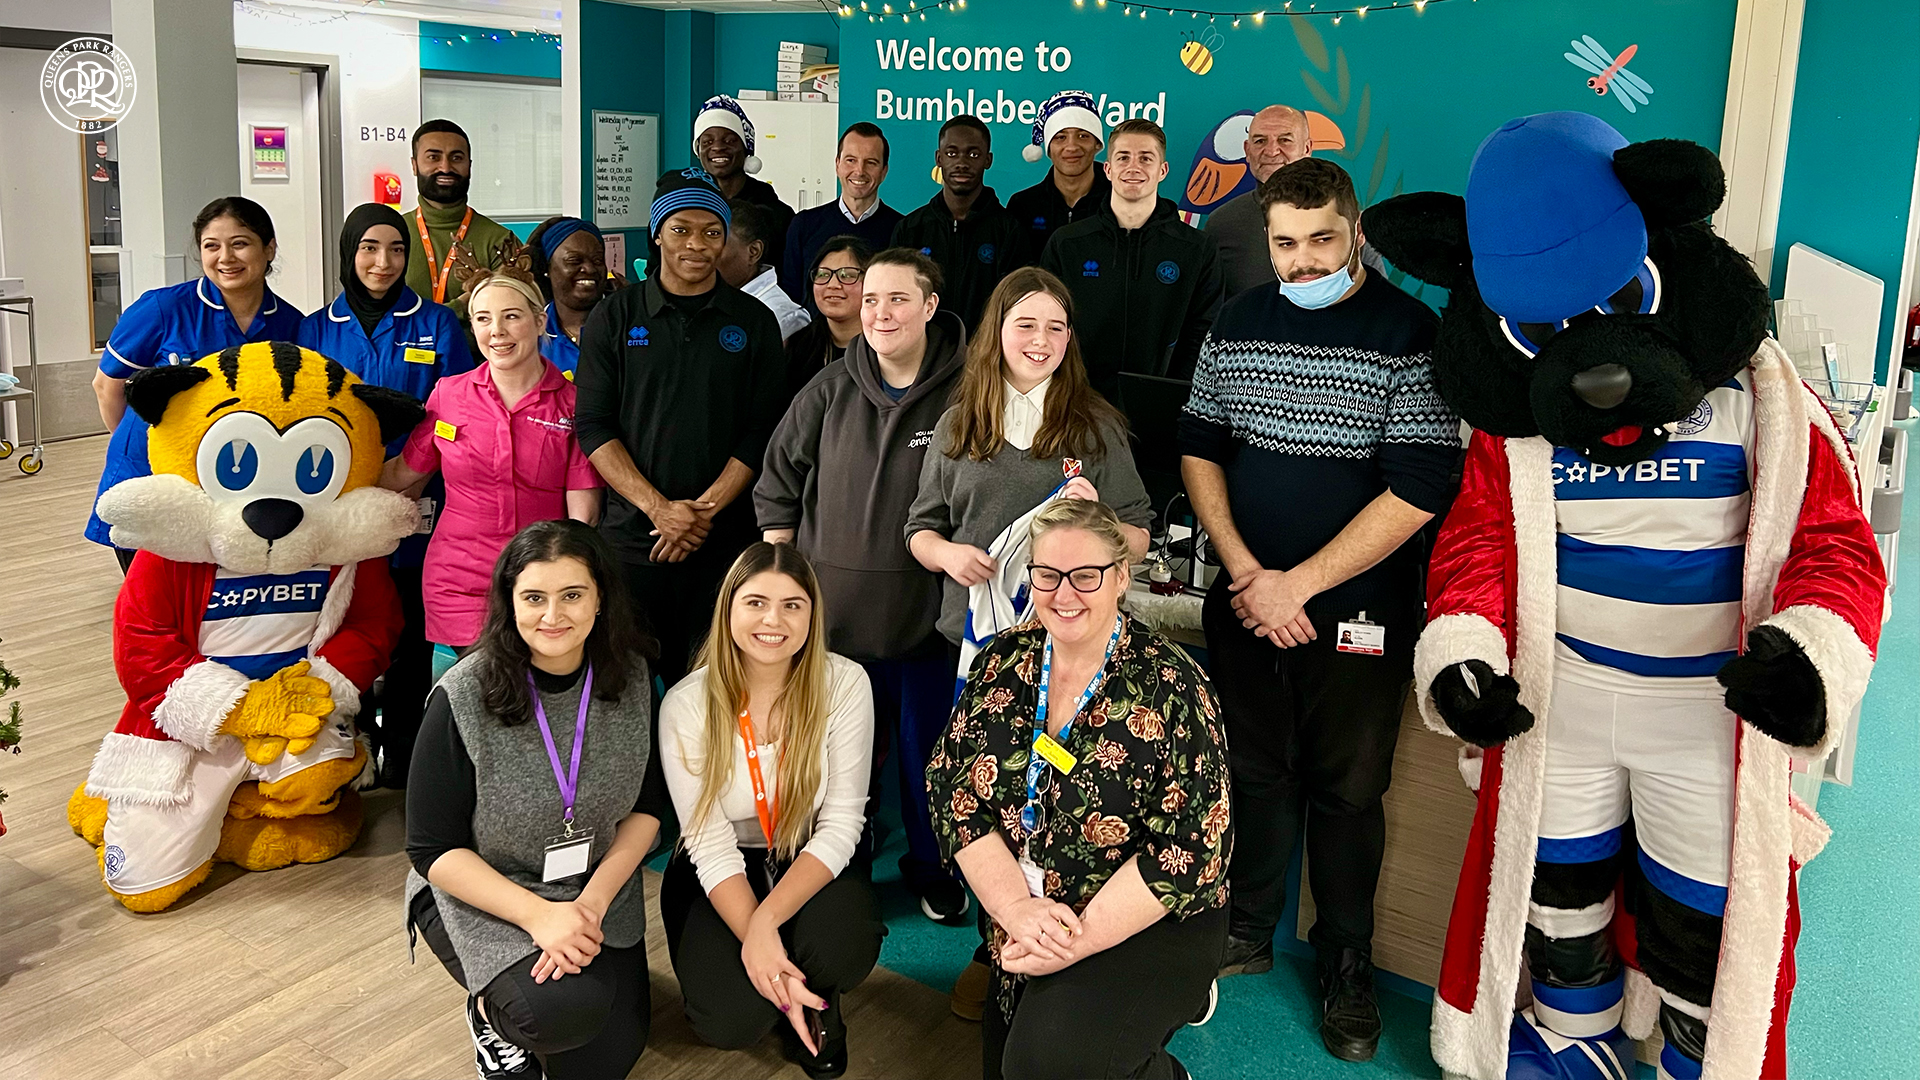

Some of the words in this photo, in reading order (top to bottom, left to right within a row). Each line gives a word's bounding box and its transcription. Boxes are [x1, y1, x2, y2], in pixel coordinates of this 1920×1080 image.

[876, 37, 1023, 72] Welcome
[1035, 41, 1072, 72] to
[1098, 92, 1167, 128] ard
[360, 126, 407, 142] B1-B4
[1043, 650, 1051, 666] NHS
[1041, 670, 1049, 686] NHS
[1087, 677, 1100, 694] NHS
[1039, 690, 1047, 707] NHS
